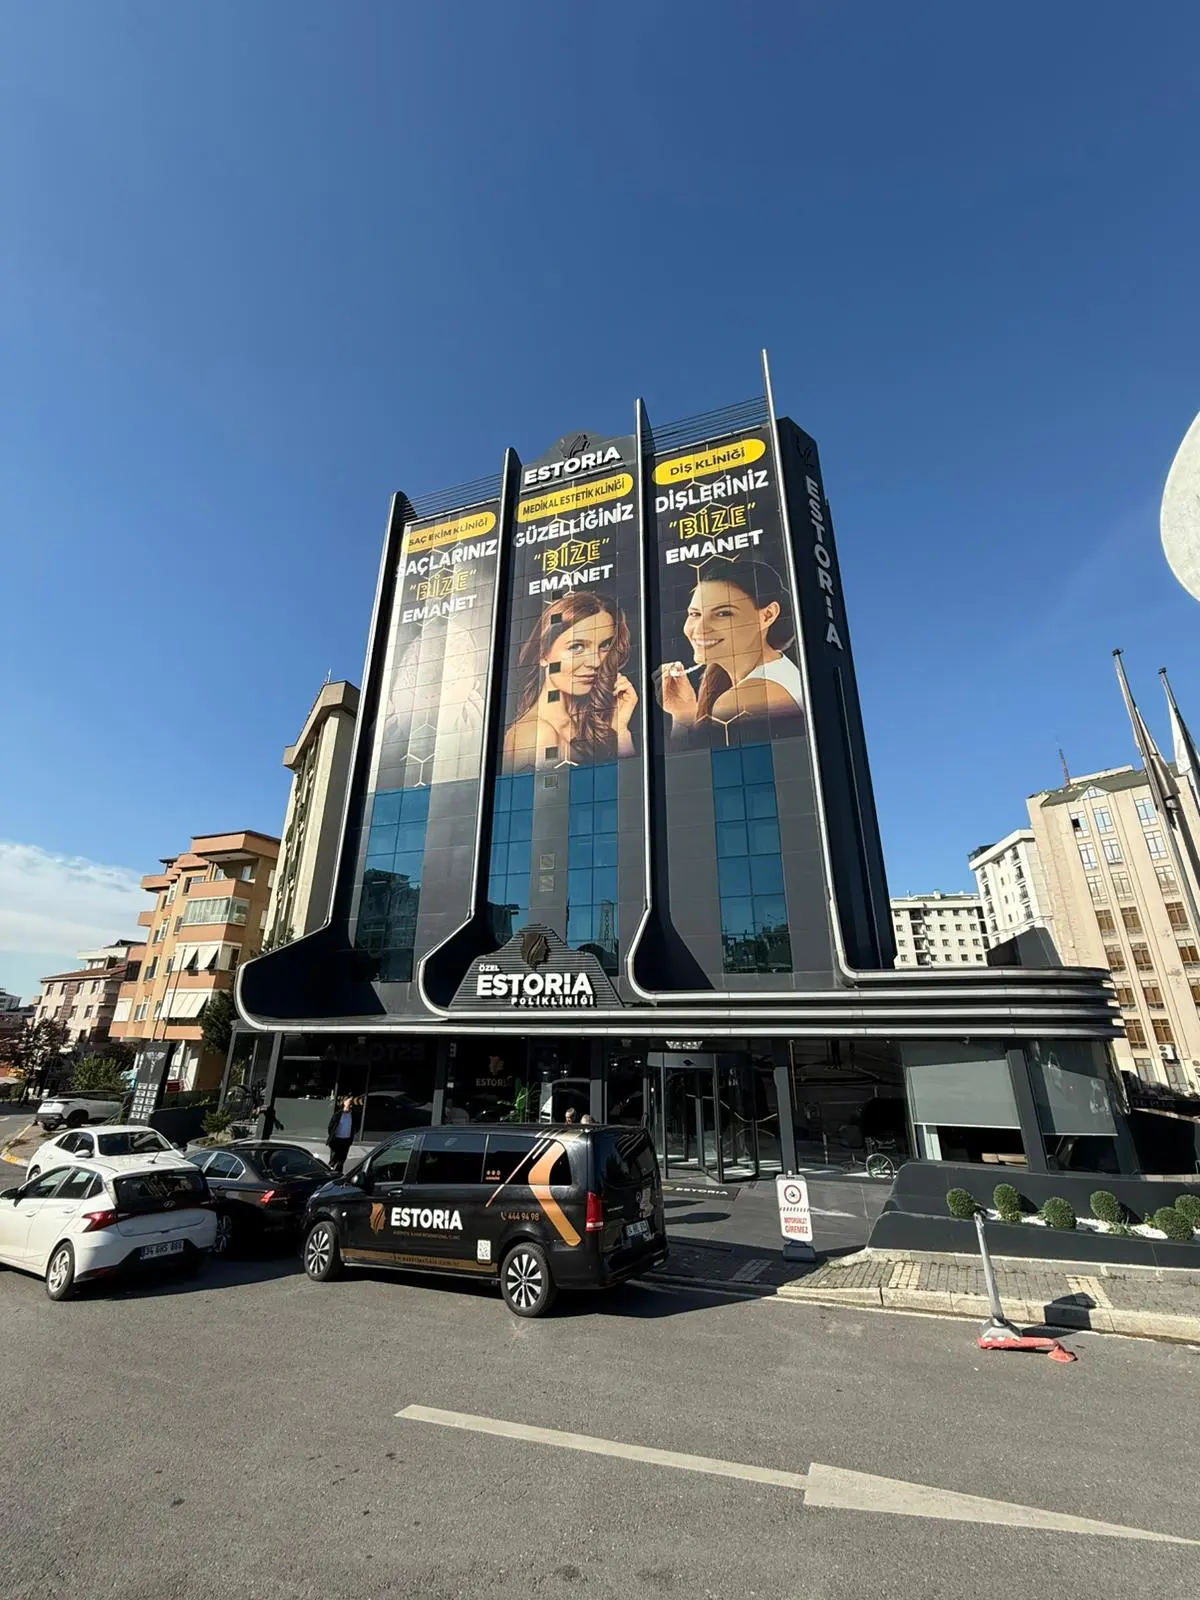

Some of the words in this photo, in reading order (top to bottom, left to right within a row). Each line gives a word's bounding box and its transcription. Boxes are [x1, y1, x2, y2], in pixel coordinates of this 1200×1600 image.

[524, 446, 621, 485] ESTORIA
[670, 463, 692, 476] DİŞ
[695, 447, 745, 469] KLİNİĞİ
[523, 497, 558, 515] MEDİKAL
[560, 488, 593, 505] ESTETİK
[595, 477, 625, 496] KLİNİĞİ
[655, 468, 769, 513] DİŞLERİNİZ
[409, 536, 427, 546] SAÇ
[428, 529, 452, 541] EKİM
[453, 517, 488, 534] KLİNİĞİ
[513, 503, 634, 548] GÜZELLİĞİNİZ
[666, 529, 763, 564] EMANET
[806, 476, 843, 649] ESTORIA
[529, 564, 614, 595] EMANET
[402, 595, 477, 623] EMANET
[478, 963, 500, 972] ÖZEL
[476, 972, 594, 996] ESTORIA
[511, 995, 594, 1006] POLİKLİNİĞİ
[390, 1207, 463, 1230] ESTORIA
